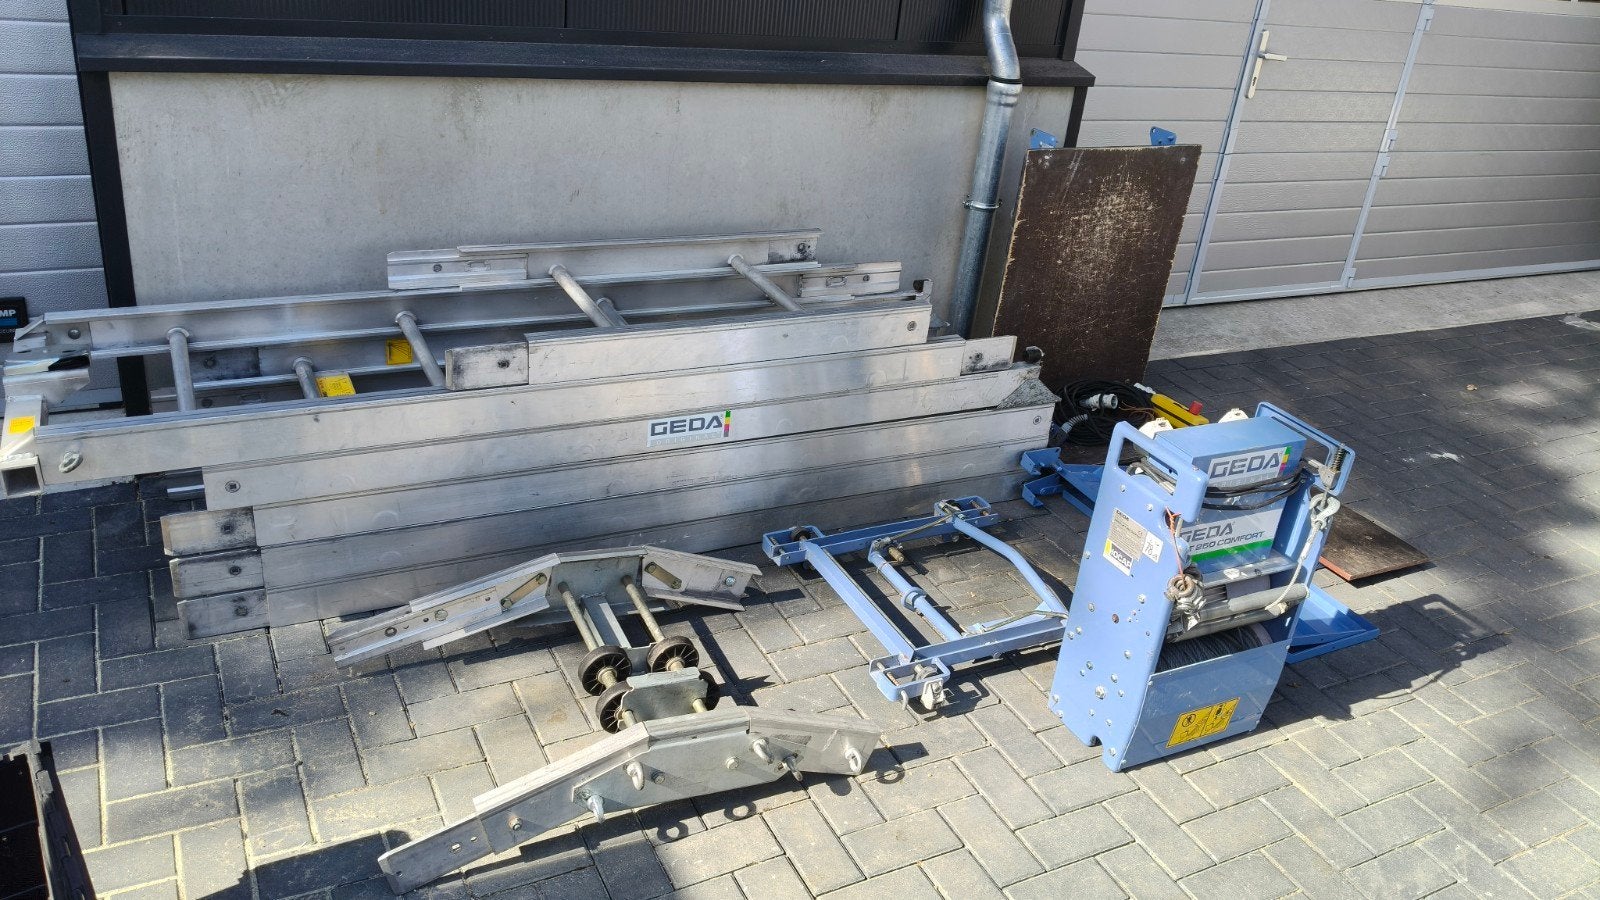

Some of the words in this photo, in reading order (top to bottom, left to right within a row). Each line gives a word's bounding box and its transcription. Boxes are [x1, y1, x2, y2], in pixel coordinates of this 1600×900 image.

[650, 415, 723, 436] GEDA
[1210, 452, 1280, 479] GEDA
[1180, 522, 1233, 543] GEDA
[1217, 531, 1265, 546] COMFORT
